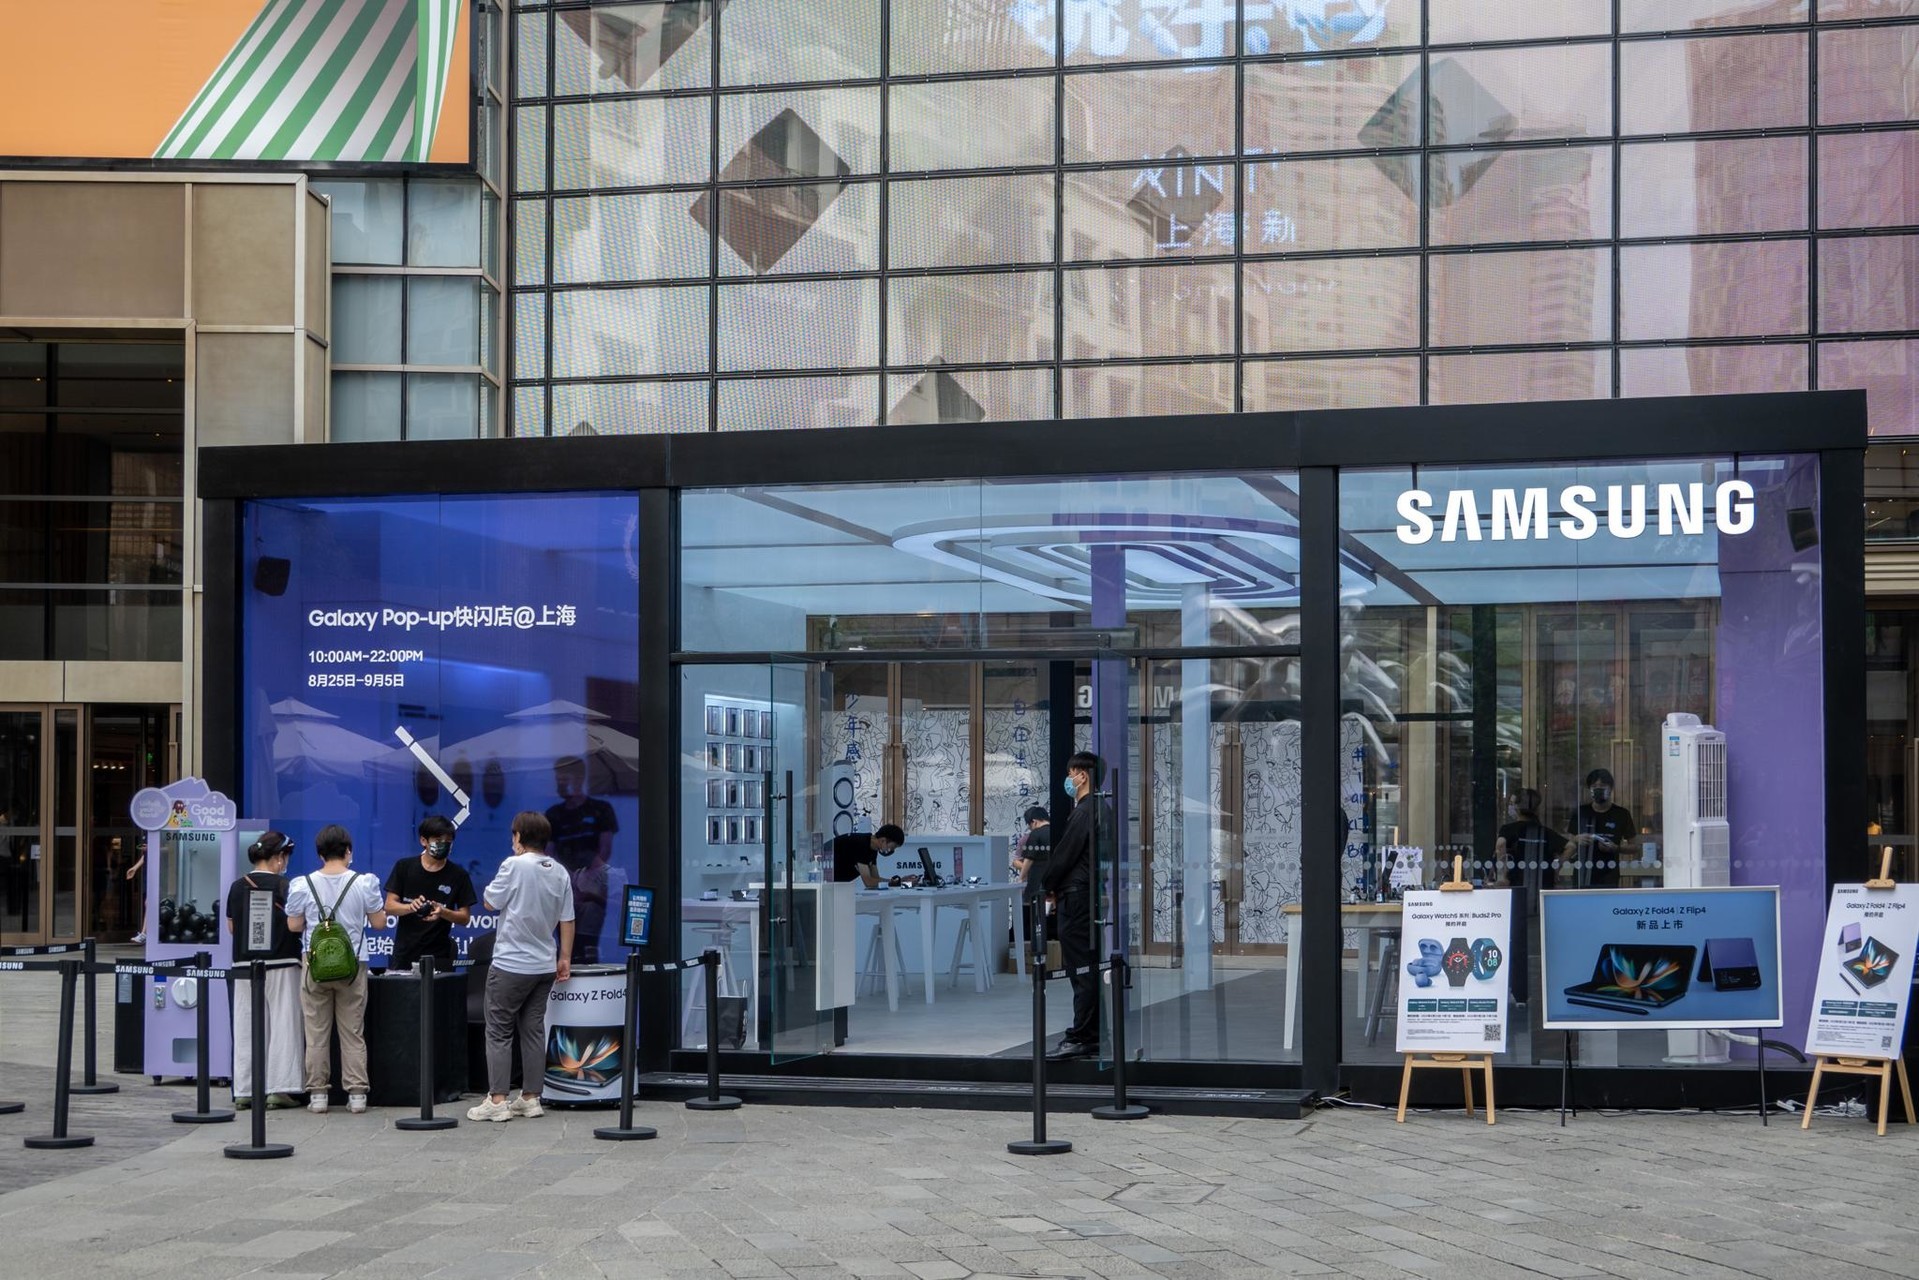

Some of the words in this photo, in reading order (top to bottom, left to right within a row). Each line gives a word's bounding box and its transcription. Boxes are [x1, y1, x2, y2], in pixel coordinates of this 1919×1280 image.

[1396, 480, 1755, 544] SAMSUNG
[308, 609, 378, 631] Galaxy
[383, 605, 577, 631] Pop-up快闪店@上海
[308, 650, 424, 663] 10:00AM-22:00PM
[308, 674, 404, 687] 8月25日-9月5日
[190, 804, 226, 816] Good
[198, 816, 231, 827] Vibes
[166, 832, 216, 842] SAMSUNG
[895, 861, 943, 870] SAMSNG
[1612, 907, 1644, 916] Galaxy
[1686, 907, 1707, 916] Flip4
[1636, 919, 1684, 930] 新品上市
[1487, 949, 1498, 958] 10
[115, 965, 154, 974] SAMSUNG
[186, 968, 225, 978] SAMSUNG
[550, 990, 590, 1004] Galaxy
[591, 990, 599, 1001] Z
